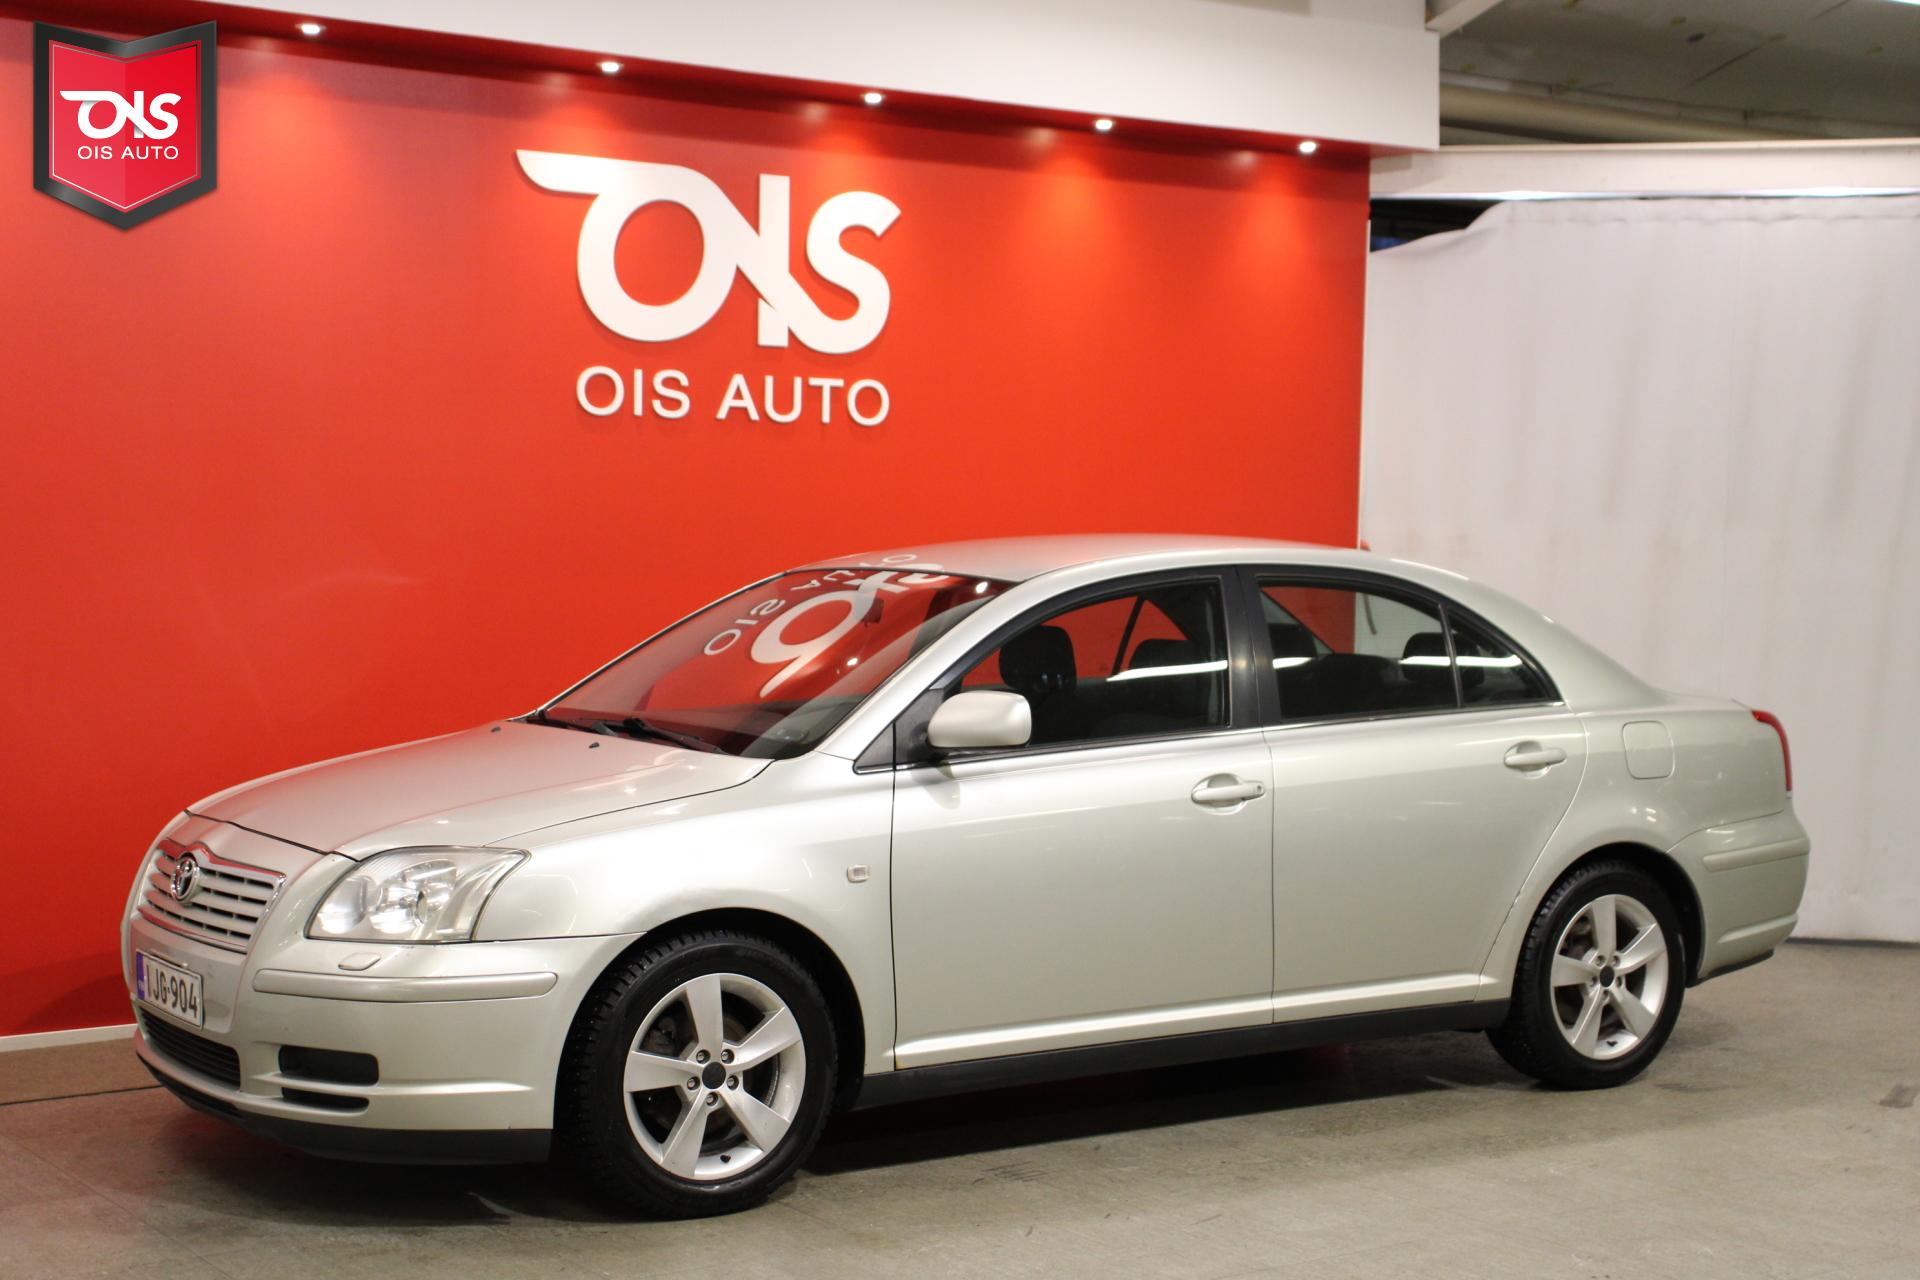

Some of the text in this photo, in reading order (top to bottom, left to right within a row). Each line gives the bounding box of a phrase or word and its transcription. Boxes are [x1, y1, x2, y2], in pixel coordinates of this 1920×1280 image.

[516, 149, 901, 354] OIS
[576, 365, 890, 426] OIS AUTO
